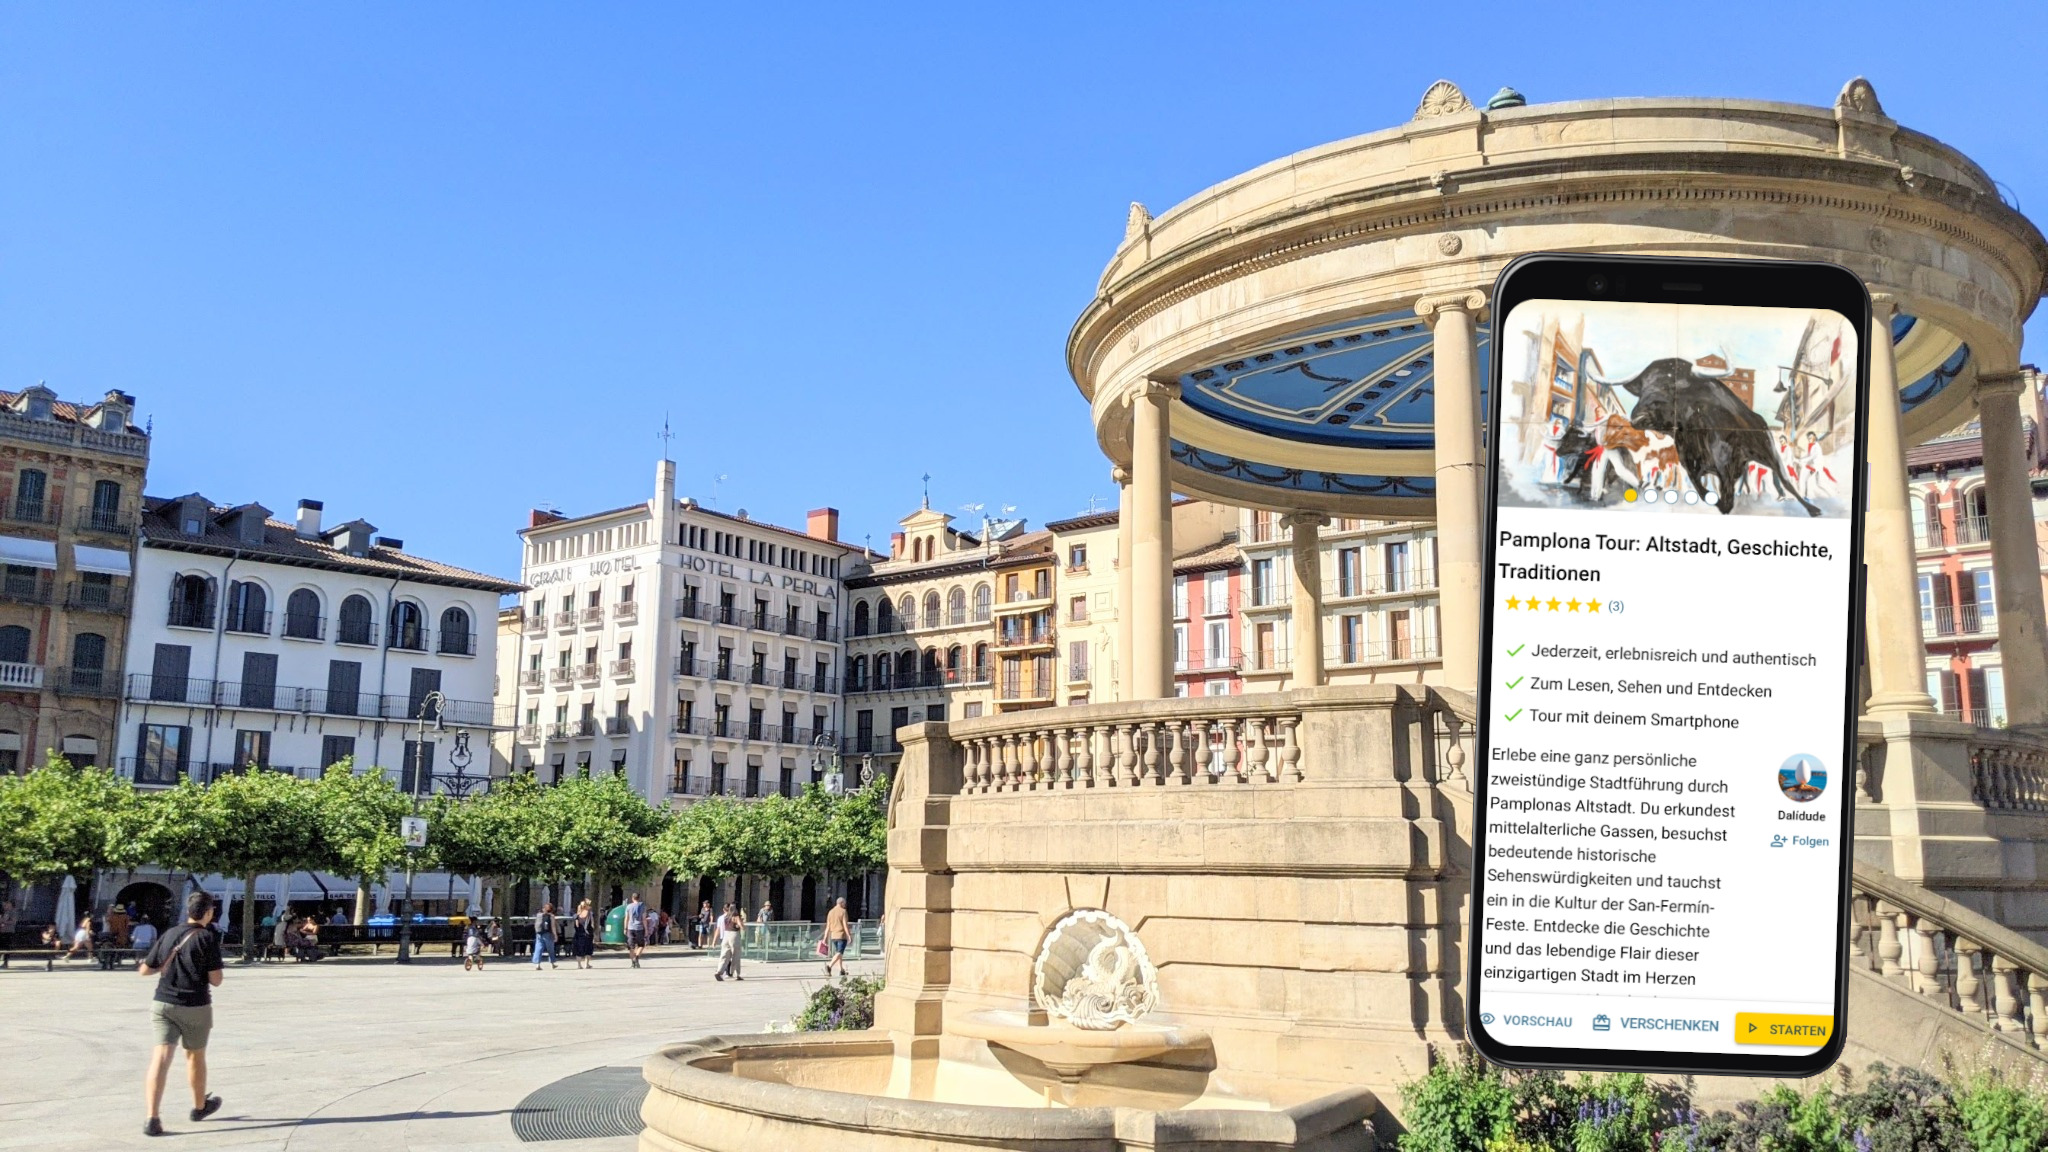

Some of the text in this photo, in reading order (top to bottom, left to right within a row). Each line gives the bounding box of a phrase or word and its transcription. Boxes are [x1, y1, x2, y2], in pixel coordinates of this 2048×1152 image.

[1499, 530, 1832, 560] Pamplona Tour: Altstadt, Geschichte,
[589, 554, 642, 577] HOTEL
[1497, 563, 1600, 581] Traditionen
[680, 553, 836, 600] HOTEL LA PERLA
[1608, 601, 1624, 613] (3)
[1531, 644, 1816, 666] Jederzeit, erlebnisreich und authentisch
[1530, 677, 1771, 697] Zum Lesen, Sehen und Entdecken
[1529, 709, 1739, 730] Tour mit deinem Smartphone
[1492, 748, 1696, 767] Erlebe eine ganz persönliche
[1490, 774, 1728, 794] zweistündige Stadtführung durch
[1490, 797, 1735, 817] Pamplonas Altstadt. Du erkundest
[1489, 821, 1727, 841] mittelalterliche Gassen, besuchst
[1792, 836, 1829, 848] Folgen
[1488, 844, 1656, 863] bedeutende historische
[1487, 869, 1721, 889] Sehenswürdigkeiten und tauchst
[1486, 894, 1507, 906] ein
[1512, 895, 1524, 907] in
[1528, 895, 1550, 908] die
[1554, 896, 1597, 909] Kultur
[1600, 897, 1624, 910] der
[1486, 918, 1709, 937] Feste. Entdecke die Geschichte
[1485, 942, 1699, 961] und das lebendige Flair dieser
[1483, 966, 1695, 985] einzigartigen Stadt im Herzen
[1503, 1015, 1572, 1027] VORSCHAU
[1620, 1018, 1719, 1031] VERSCHENKEN
[1769, 1024, 1827, 1038] STARTEN
